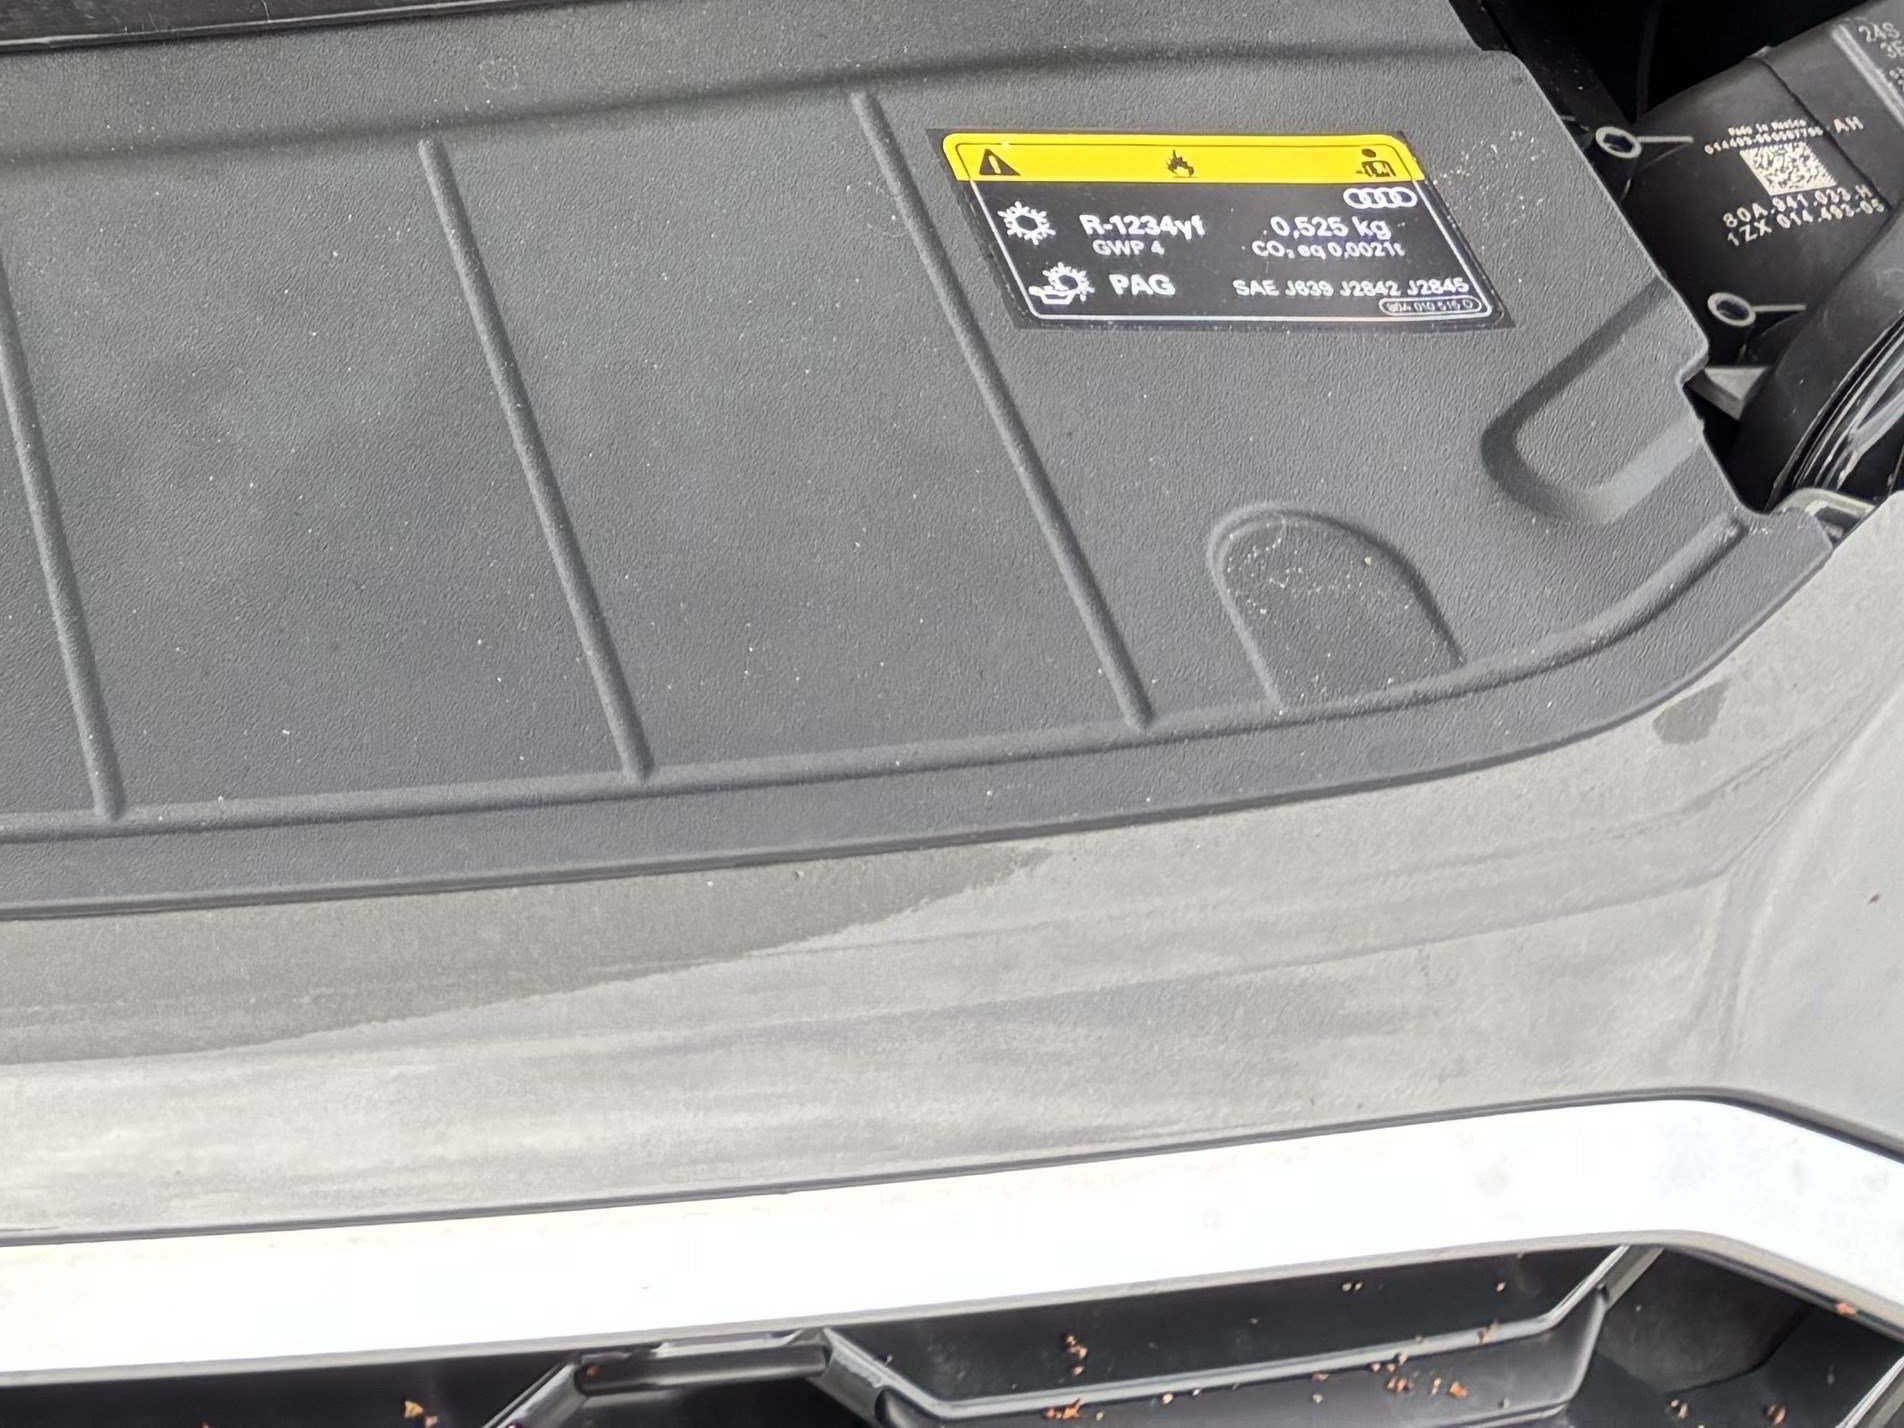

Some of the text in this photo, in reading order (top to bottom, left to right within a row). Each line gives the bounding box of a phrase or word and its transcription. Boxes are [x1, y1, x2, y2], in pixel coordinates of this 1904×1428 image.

[1834, 116, 1864, 133] AH
[1079, 214, 1391, 240] R-1234yf 0,525 kg
[1728, 219, 1772, 246] 1ZX
[1093, 239, 1144, 255] GWP
[1151, 240, 1164, 255] 4
[1298, 245, 1326, 259] eq
[1109, 274, 1469, 296] PAG SAE J639 J2842 J2845
